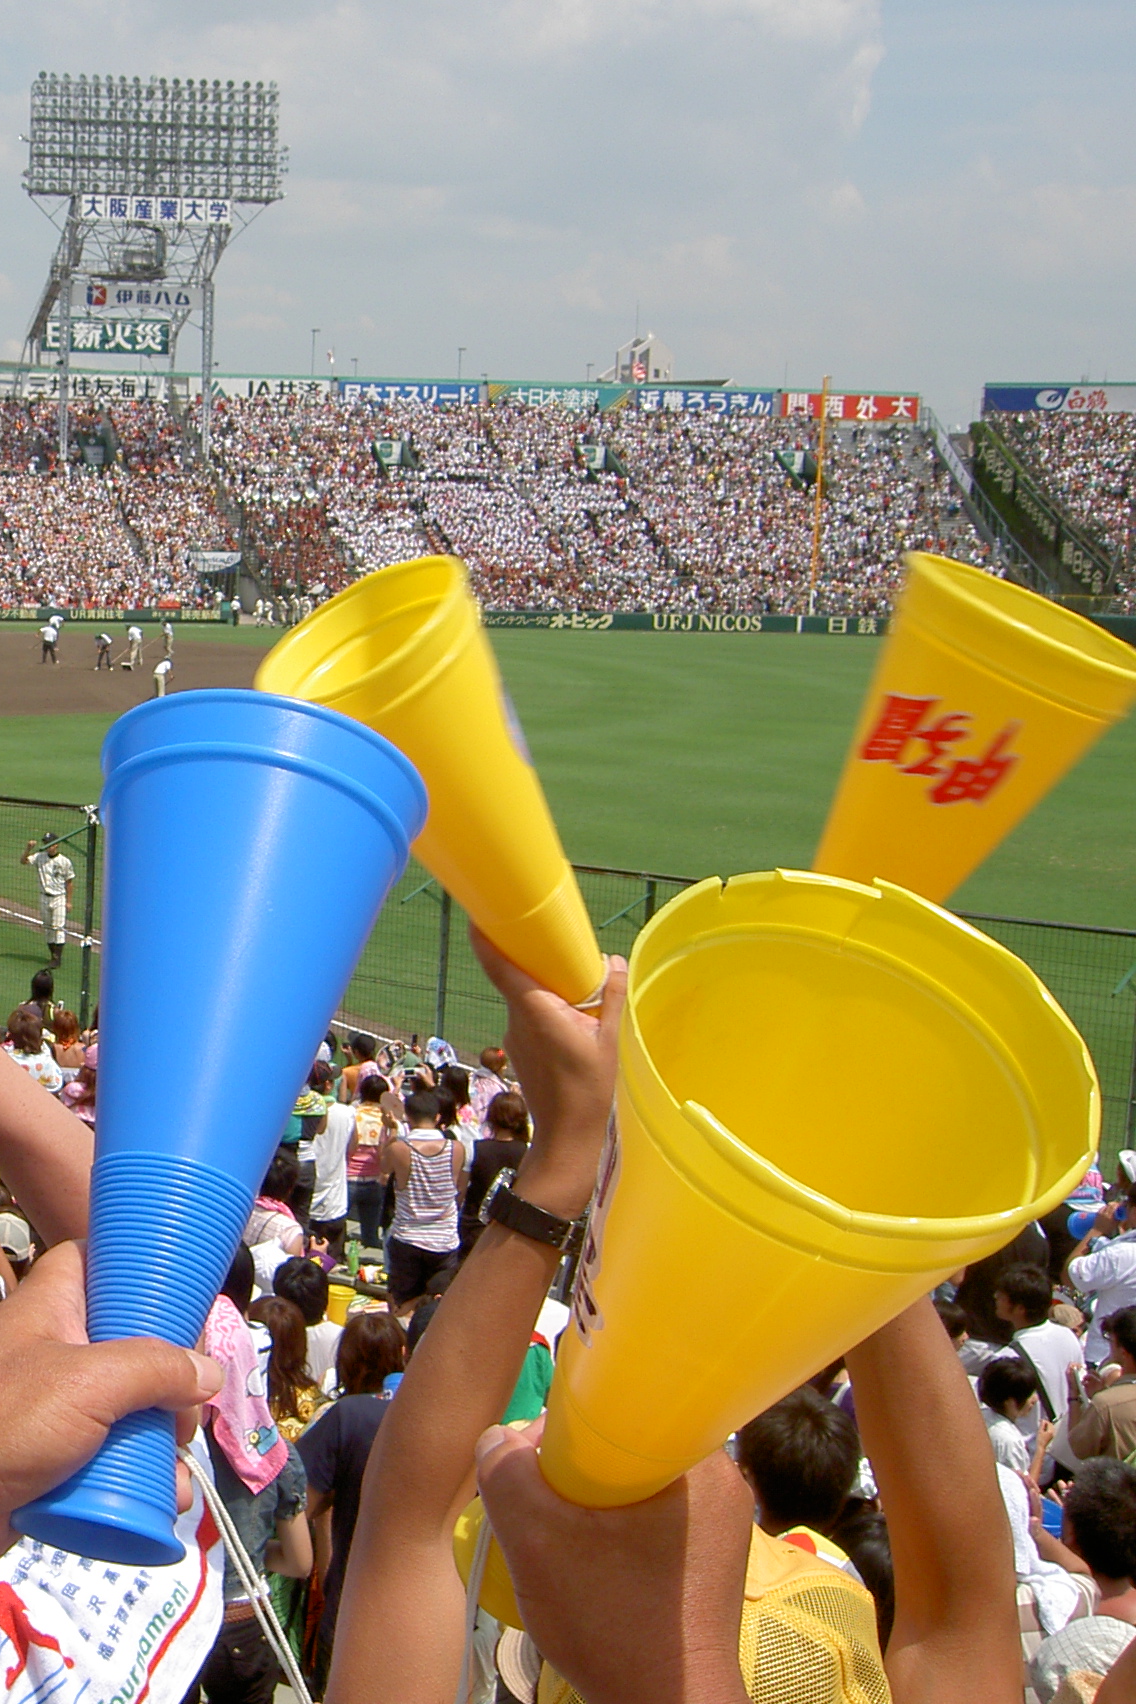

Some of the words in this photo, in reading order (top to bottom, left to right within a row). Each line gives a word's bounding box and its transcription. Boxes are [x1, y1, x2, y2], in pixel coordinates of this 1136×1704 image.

[84, 196, 228, 222] 大阪産業大学
[116, 290, 191, 306] 伊藤ハム
[46, 321, 163, 351] 日新火災
[28, 375, 157, 399] 三井住友海上
[344, 383, 476, 406] 日本エスリード
[510, 387, 599, 408] 大日本塗料
[639, 390, 771, 415] 近畿ろうきん
[787, 393, 913, 419] 関西外大
[1068, 389, 1109, 411] 白鶴
[549, 613, 614, 630] オービック
[652, 613, 692, 632] UFJ
[698, 613, 763, 632] NICOS
[100, 1579, 190, 1704] ournament
